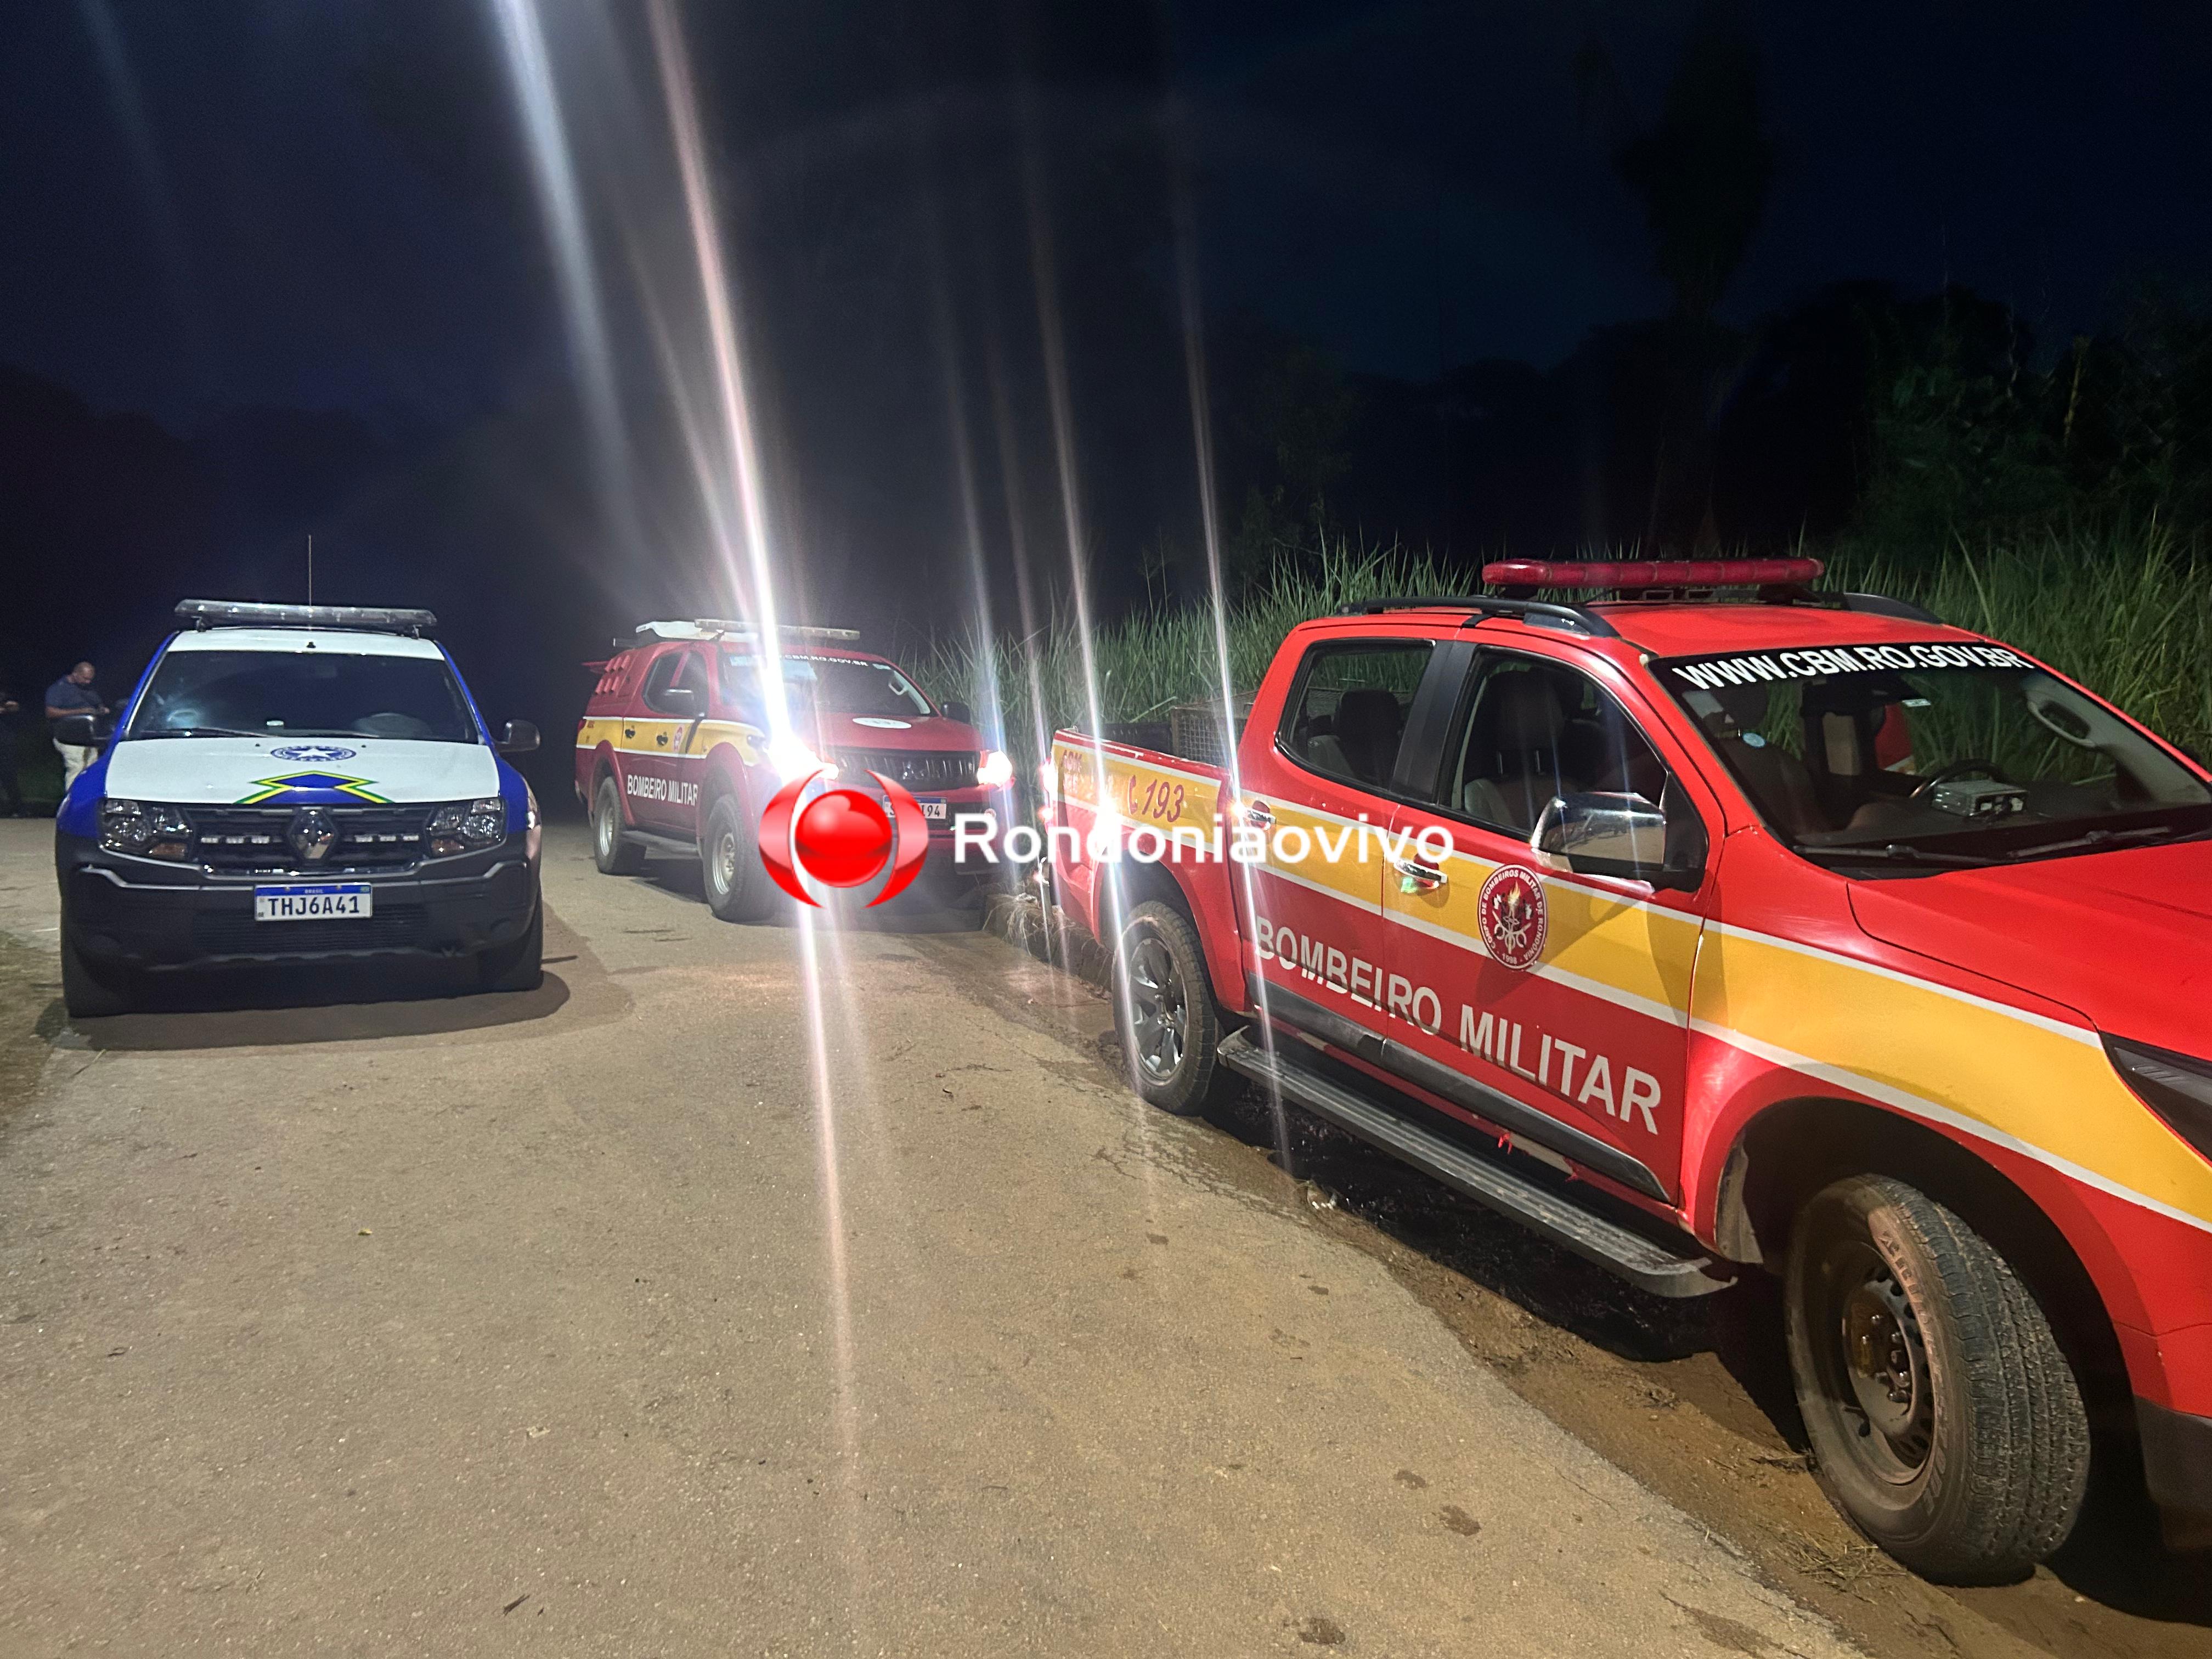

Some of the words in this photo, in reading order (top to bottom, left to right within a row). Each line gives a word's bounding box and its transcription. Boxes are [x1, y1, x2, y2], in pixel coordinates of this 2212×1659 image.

[1672, 646, 2034, 690] WWW.CBM.RO.GOV.BR
[628, 774, 667, 800] BOMBEIRO
[1142, 779, 1184, 822] 193
[1483, 870, 1519, 900] BOMBEIROS
[1520, 871, 1541, 900] MILITAR
[268, 896, 359, 916] THJ6A41
[1482, 902, 1487, 915] DE
[1537, 901, 1543, 915] DE
[1482, 917, 1496, 949] CORPO
[1255, 916, 1441, 1036] BOMBEIRO
[1459, 1004, 1661, 1135] MILITAR
